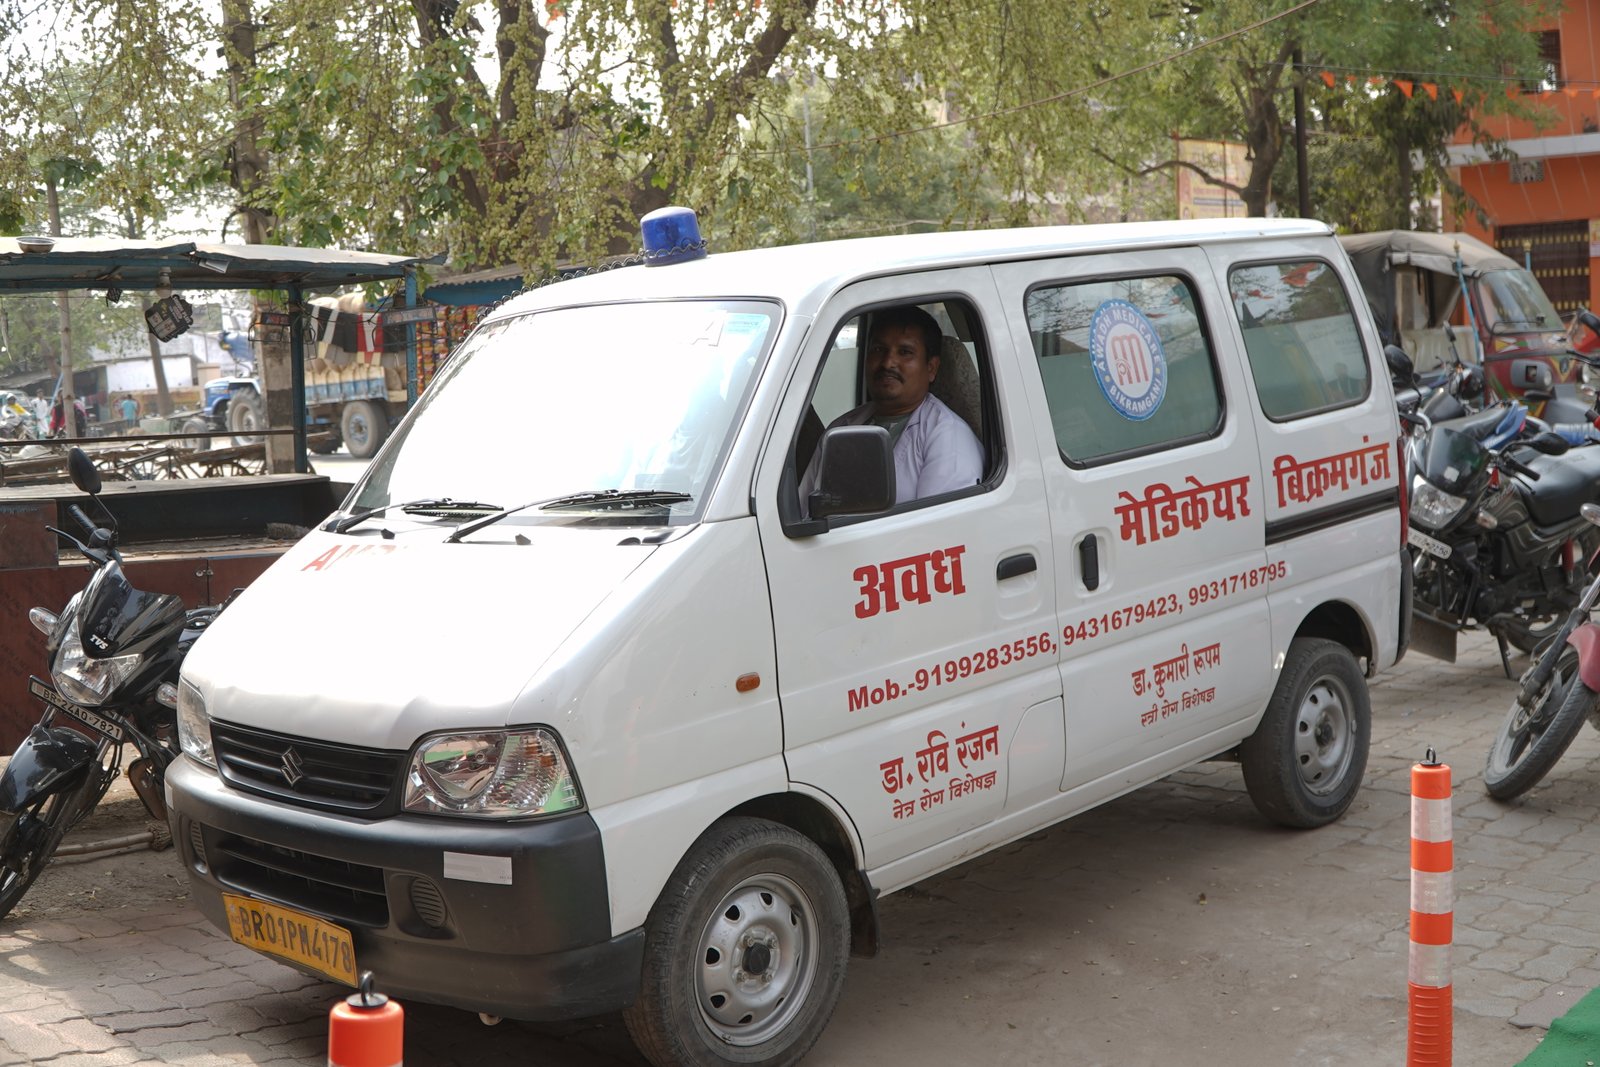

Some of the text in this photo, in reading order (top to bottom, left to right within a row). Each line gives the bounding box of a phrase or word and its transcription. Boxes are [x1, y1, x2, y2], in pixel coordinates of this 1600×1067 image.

[1097, 309, 1160, 371] AWADH MEDICARE
[1109, 378, 1162, 412] BIKRAMGANJ
[853, 545, 966, 619] अवध
[1114, 476, 1251, 545] मेडिकेयर
[1063, 594, 1183, 645] 9431679423,
[1188, 561, 1286, 605] 9931718795
[90, 634, 108, 650] TVS
[1193, 643, 1220, 675] रूपम
[1161, 699, 1178, 719] रोग
[1182, 687, 1215, 711] विशेषज्ञ
[955, 721, 999, 769] रंजन
[893, 770, 997, 819] नेत्र रोग विशेषज्ञ
[239, 906, 353, 974] BR01PM4178
